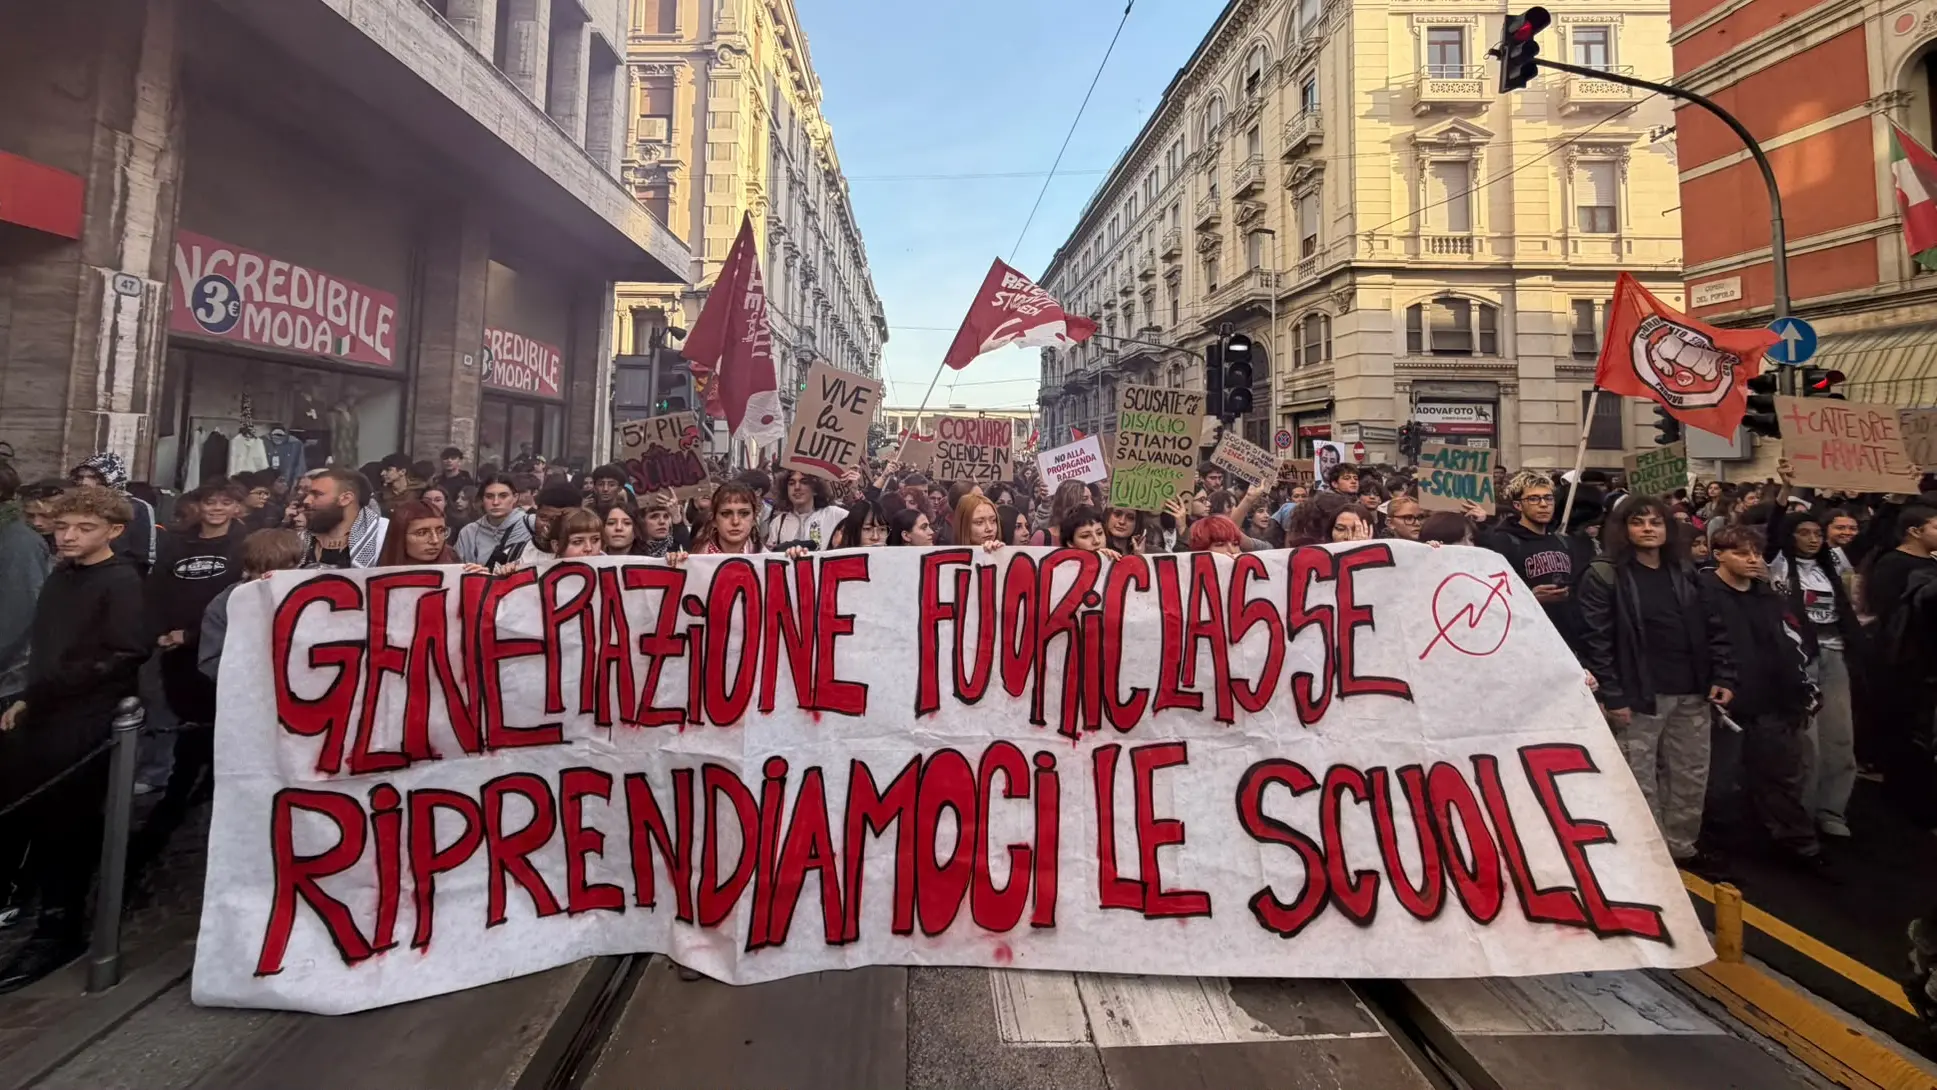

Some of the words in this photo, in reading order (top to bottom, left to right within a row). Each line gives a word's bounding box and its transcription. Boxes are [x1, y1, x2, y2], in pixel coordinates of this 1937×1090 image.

[119, 279, 137, 292] 47
[1696, 295, 1708, 303] DEL
[1710, 290, 1735, 301] POPOLO
[174, 242, 394, 361] NCREDIBILE
[196, 280, 239, 325] 3€
[243, 303, 333, 355] MODA
[494, 360, 532, 391] MODA
[822, 373, 872, 415] VIVE
[1123, 387, 1185, 415] SCUSATE
[815, 404, 845, 432] la
[1187, 404, 1198, 416] il
[1416, 406, 1474, 416] ADOVAFOTO
[622, 420, 652, 448] 5%
[656, 417, 685, 441] PIL
[939, 417, 1012, 448] CORNARO
[1121, 411, 1187, 434] DISAGIO
[794, 426, 856, 465] LUTTE
[1119, 431, 1192, 451] STIAMO
[1224, 432, 1251, 450] SOGNO
[936, 441, 989, 463] SCENDE
[992, 447, 1010, 465] IN
[1046, 453, 1097, 476] PROPAGANDA
[1054, 452, 1066, 464] NO
[1067, 447, 1086, 460] ALLA
[1117, 447, 1193, 467] SALVANDO
[941, 460, 1002, 481] PIAZZA
[1056, 465, 1091, 482] RAZZISTA
[1092, 741, 1212, 919] LE
[1236, 743, 1675, 948] SCUOLE
